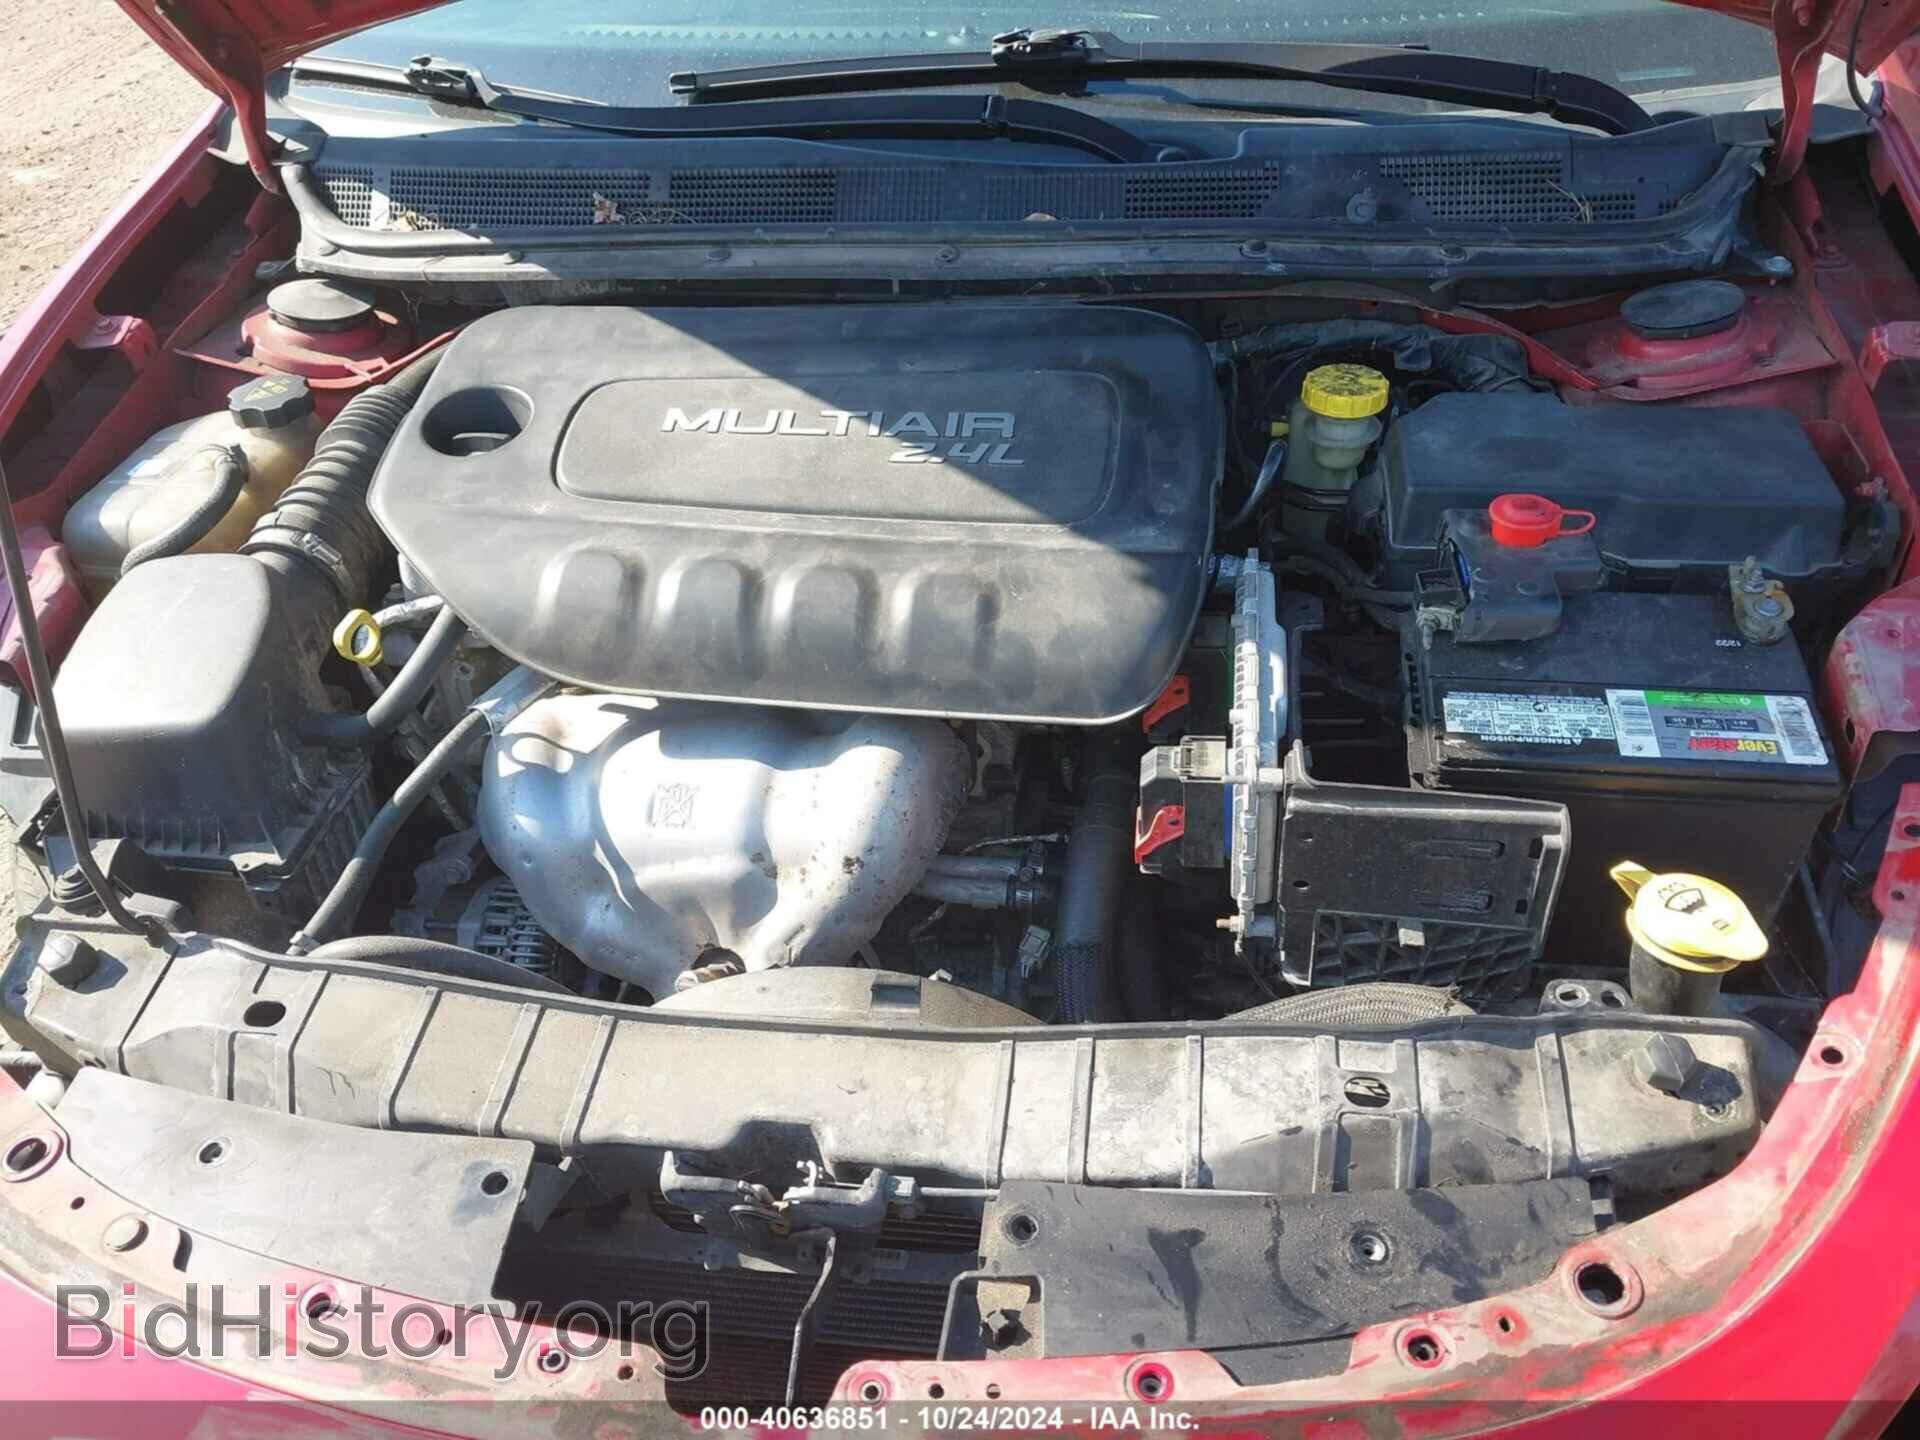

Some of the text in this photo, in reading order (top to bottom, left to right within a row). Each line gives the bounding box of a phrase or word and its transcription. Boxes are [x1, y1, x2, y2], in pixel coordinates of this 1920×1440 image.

[660, 407, 1015, 438] MULTIAIR
[888, 442, 1025, 465] 2.4L
[1688, 735, 1778, 755] EverStart
